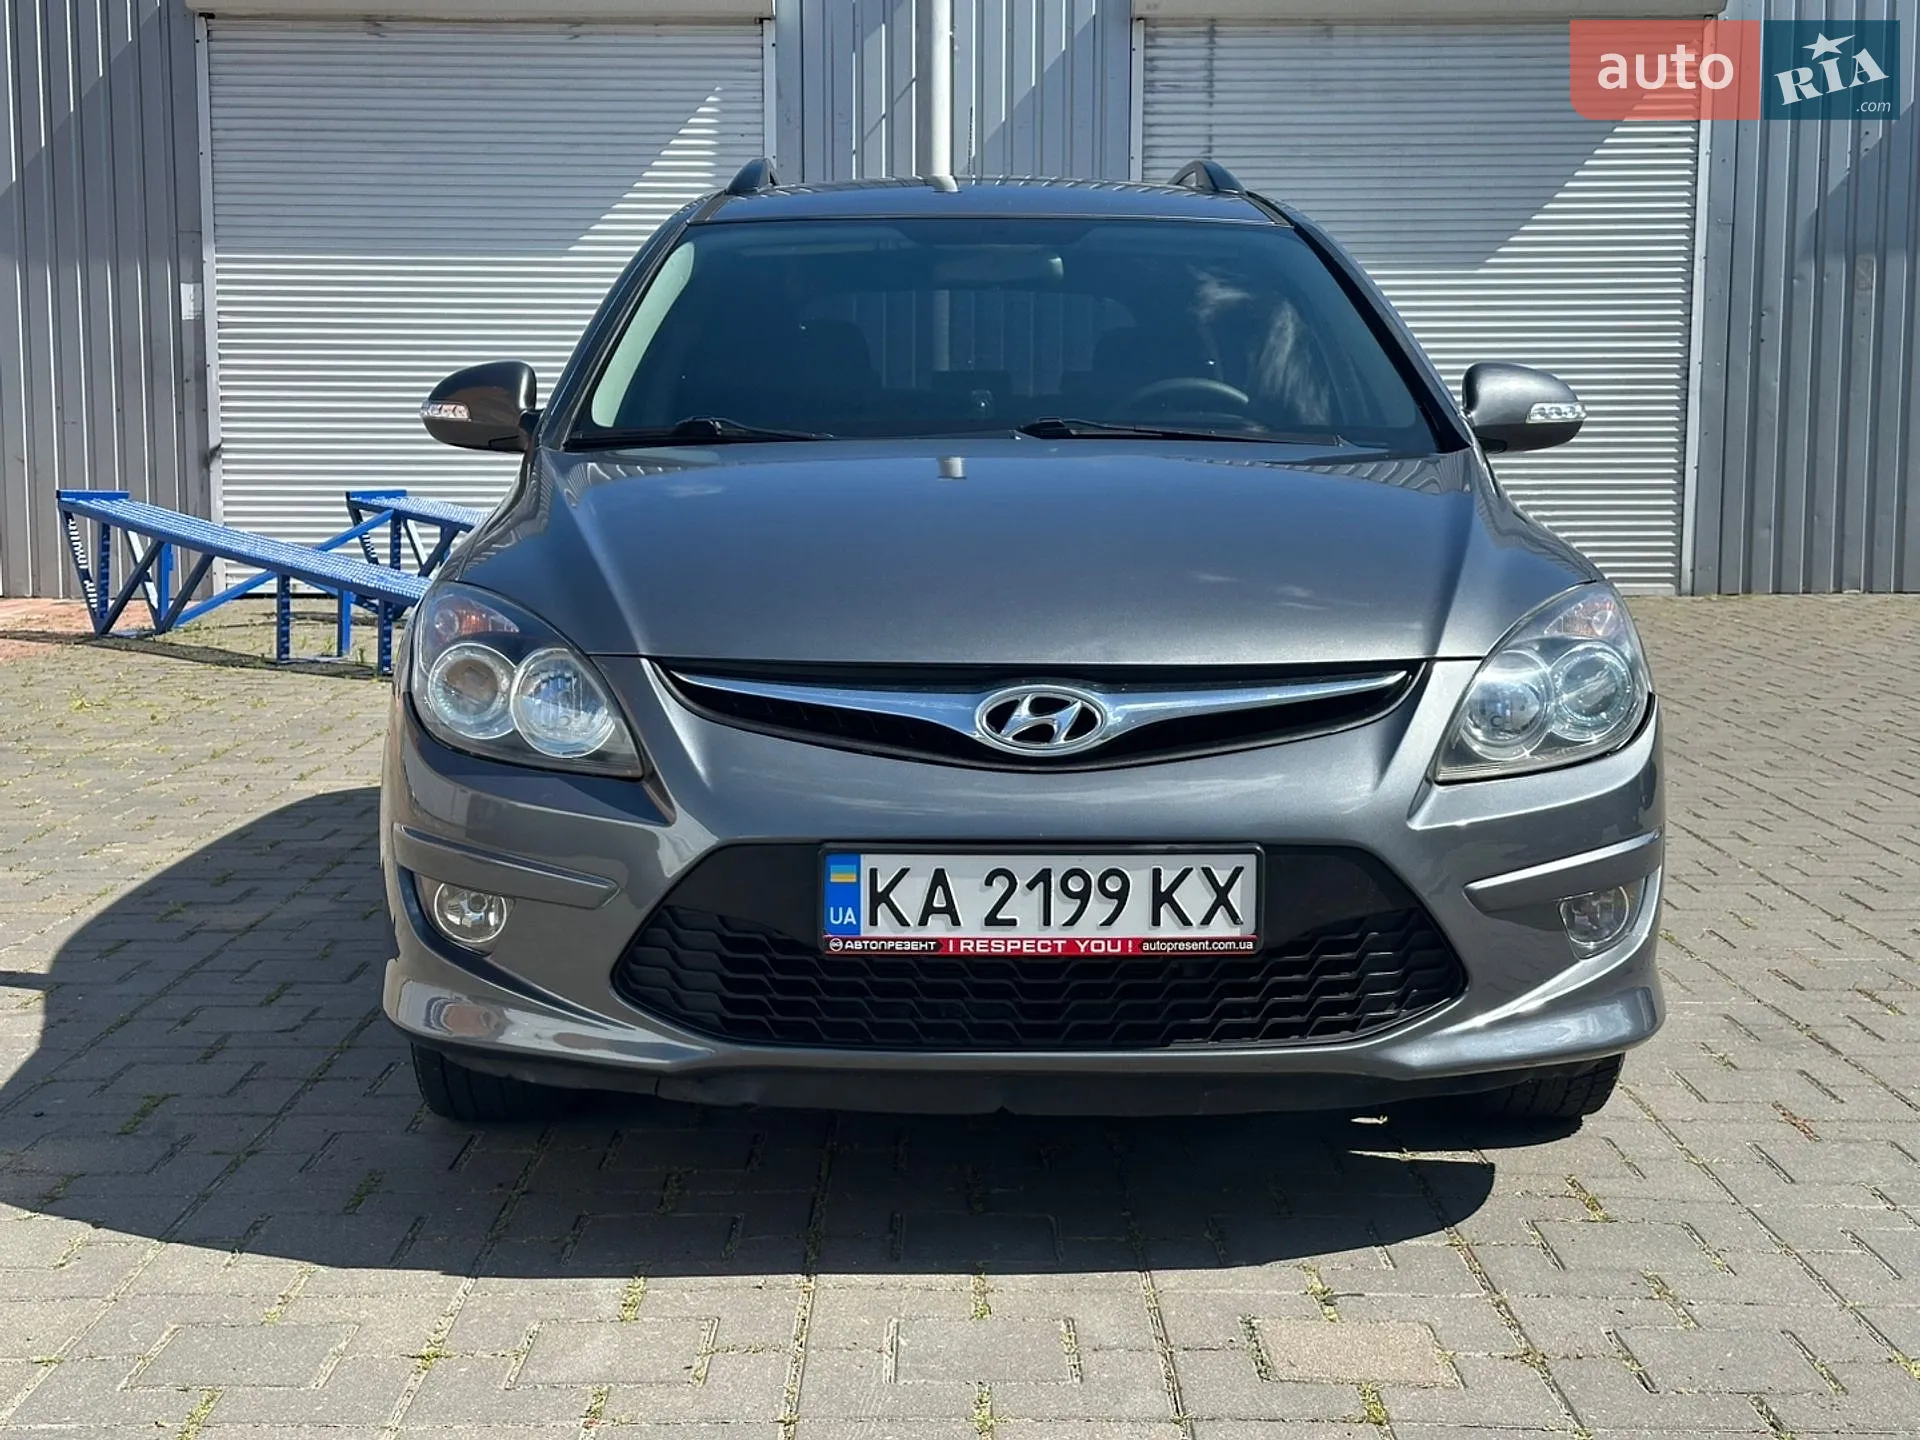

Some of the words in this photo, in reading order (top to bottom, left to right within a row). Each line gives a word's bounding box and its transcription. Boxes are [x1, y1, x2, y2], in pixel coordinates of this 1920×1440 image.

[868, 867, 962, 927] KA
[984, 867, 1131, 927] 2199
[1150, 866, 1245, 927] KX
[830, 907, 857, 925] UA
[844, 939, 936, 951] АВТОПРЕЗЕНТ
[960, 939, 1065, 953] RESPECT
[1142, 939, 1254, 953] autopresent.com.ua
